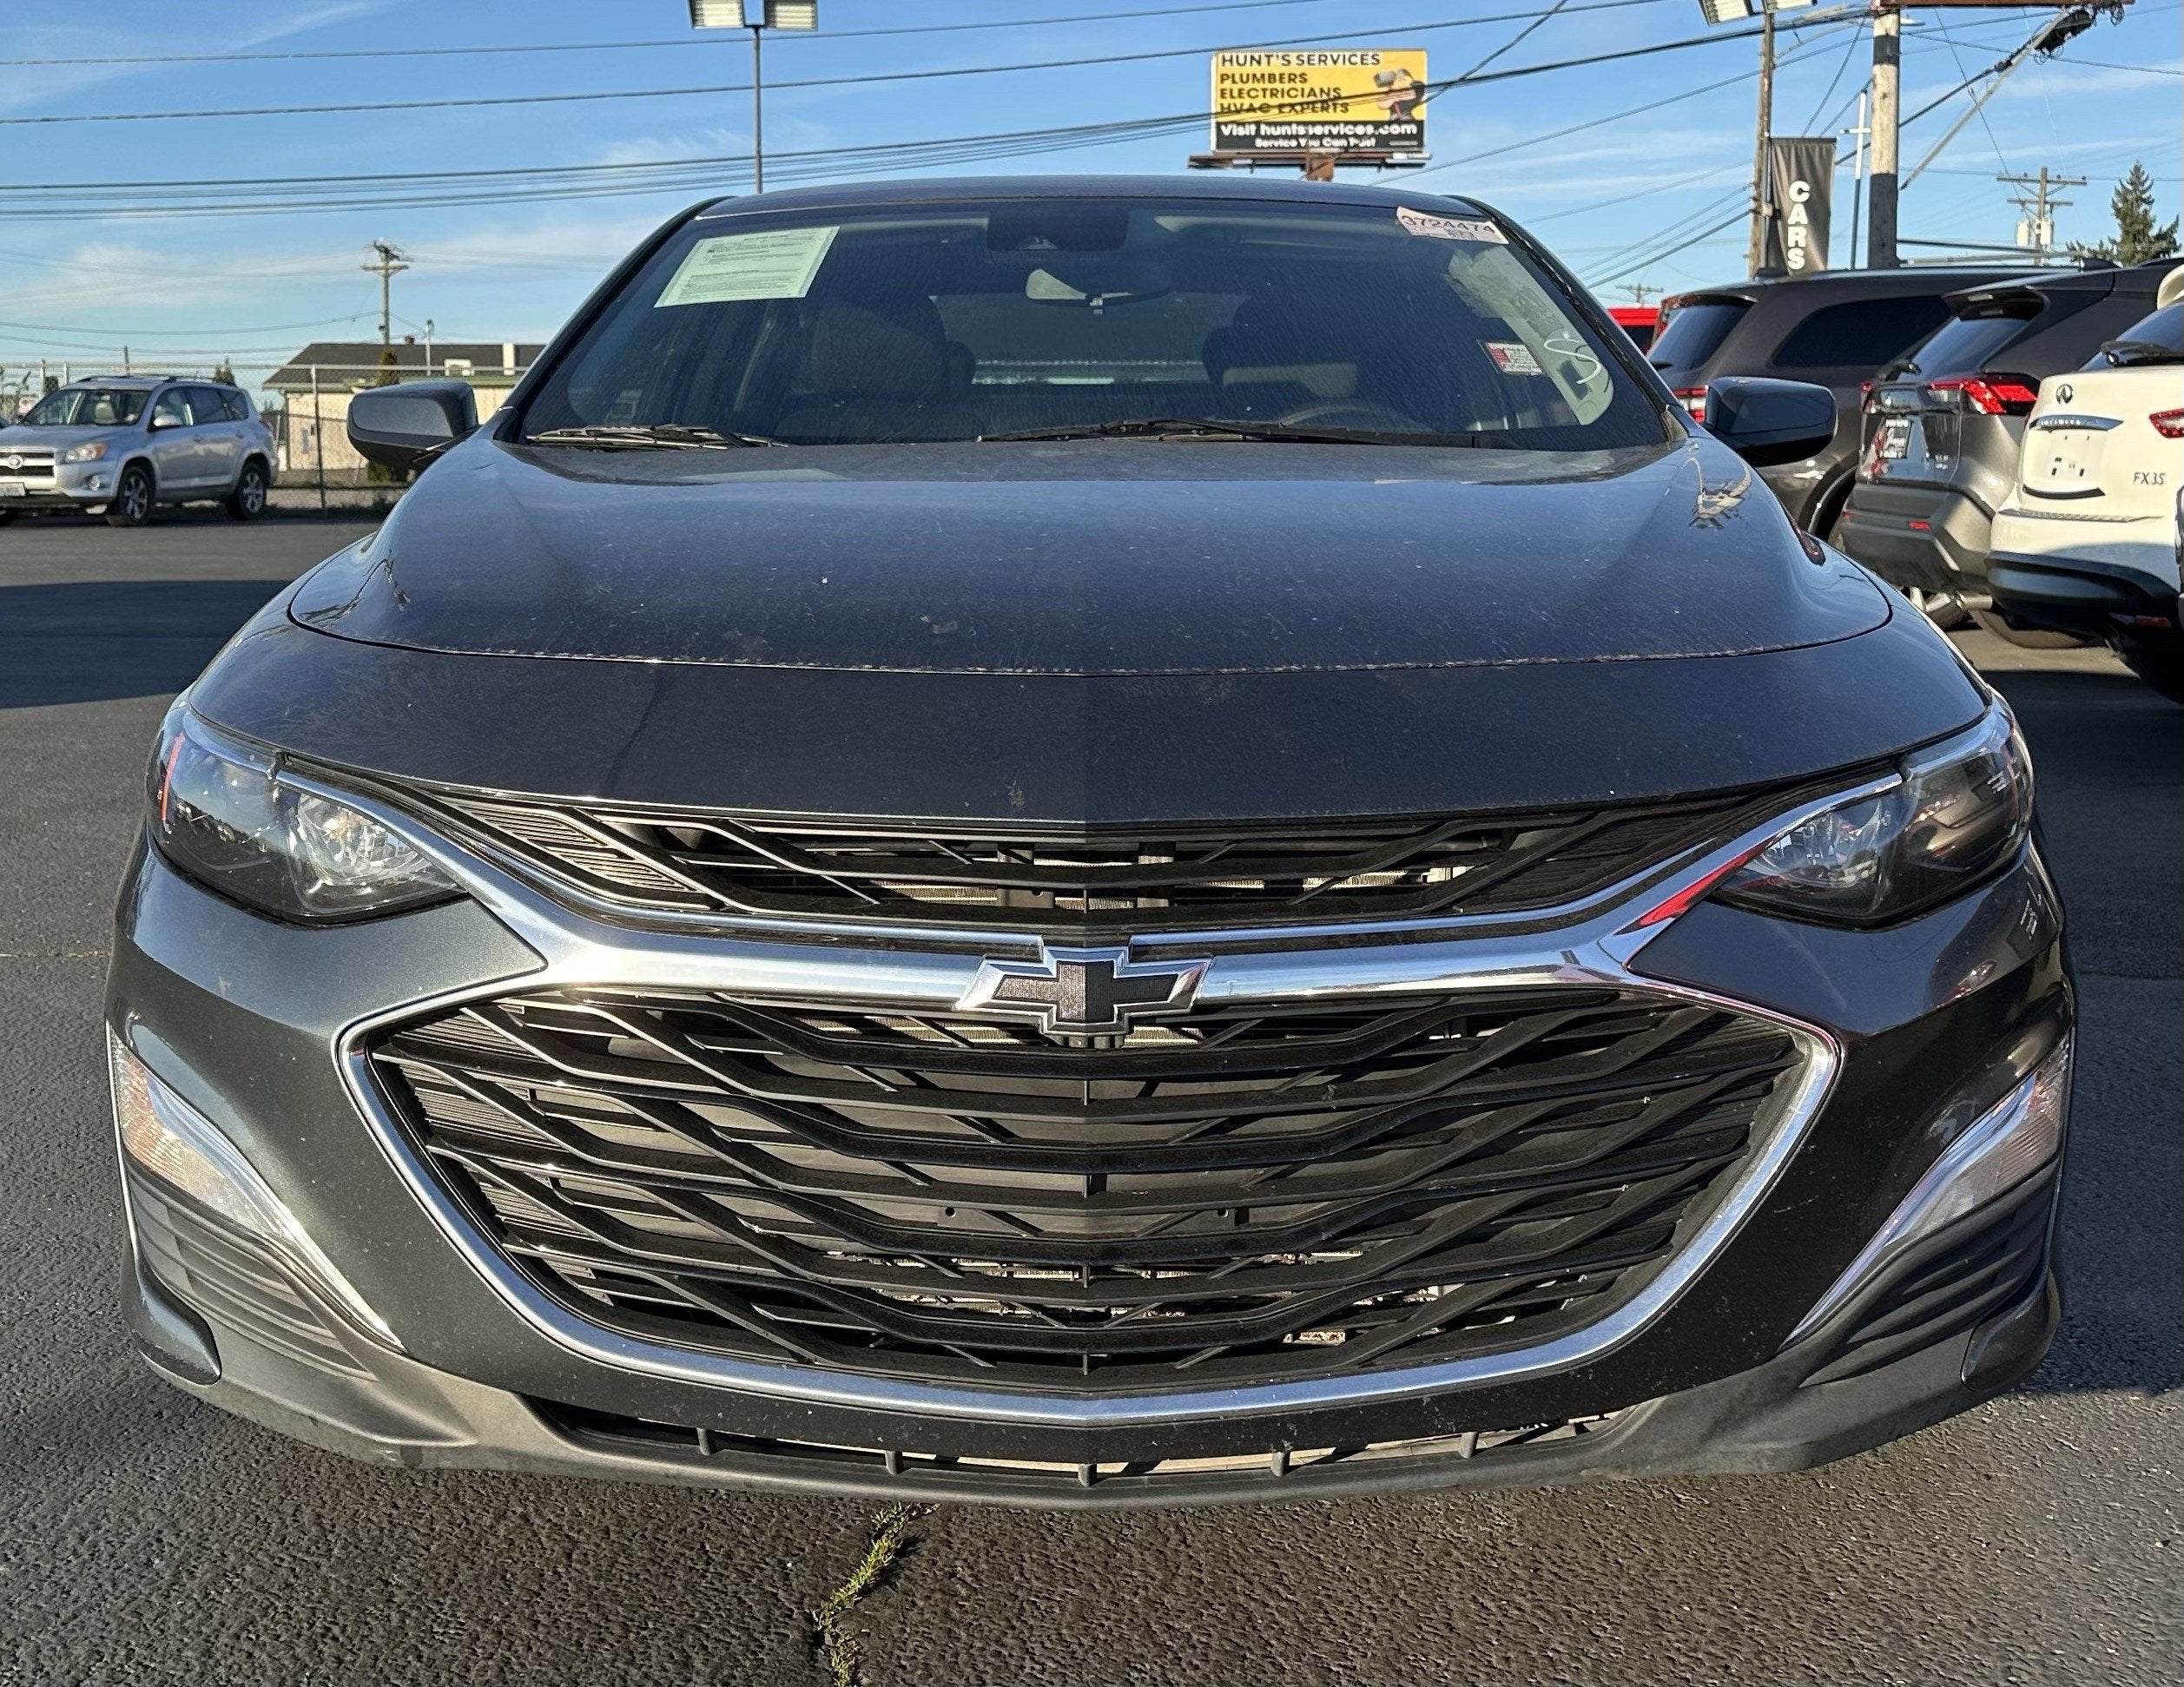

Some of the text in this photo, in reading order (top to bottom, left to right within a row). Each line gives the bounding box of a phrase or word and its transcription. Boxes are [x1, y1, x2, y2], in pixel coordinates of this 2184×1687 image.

[1222, 53, 1381, 67] HUNT'S SERVICES
[1219, 72, 1308, 84] PLUMBERS
[1219, 86, 1342, 100] ELECTRICIANS
[1219, 102, 1349, 114] HVAC EXPERTS
[1220, 122, 1257, 136] Visit
[1787, 180, 1811, 270] CARS
[2133, 471, 2167, 485] FX35
